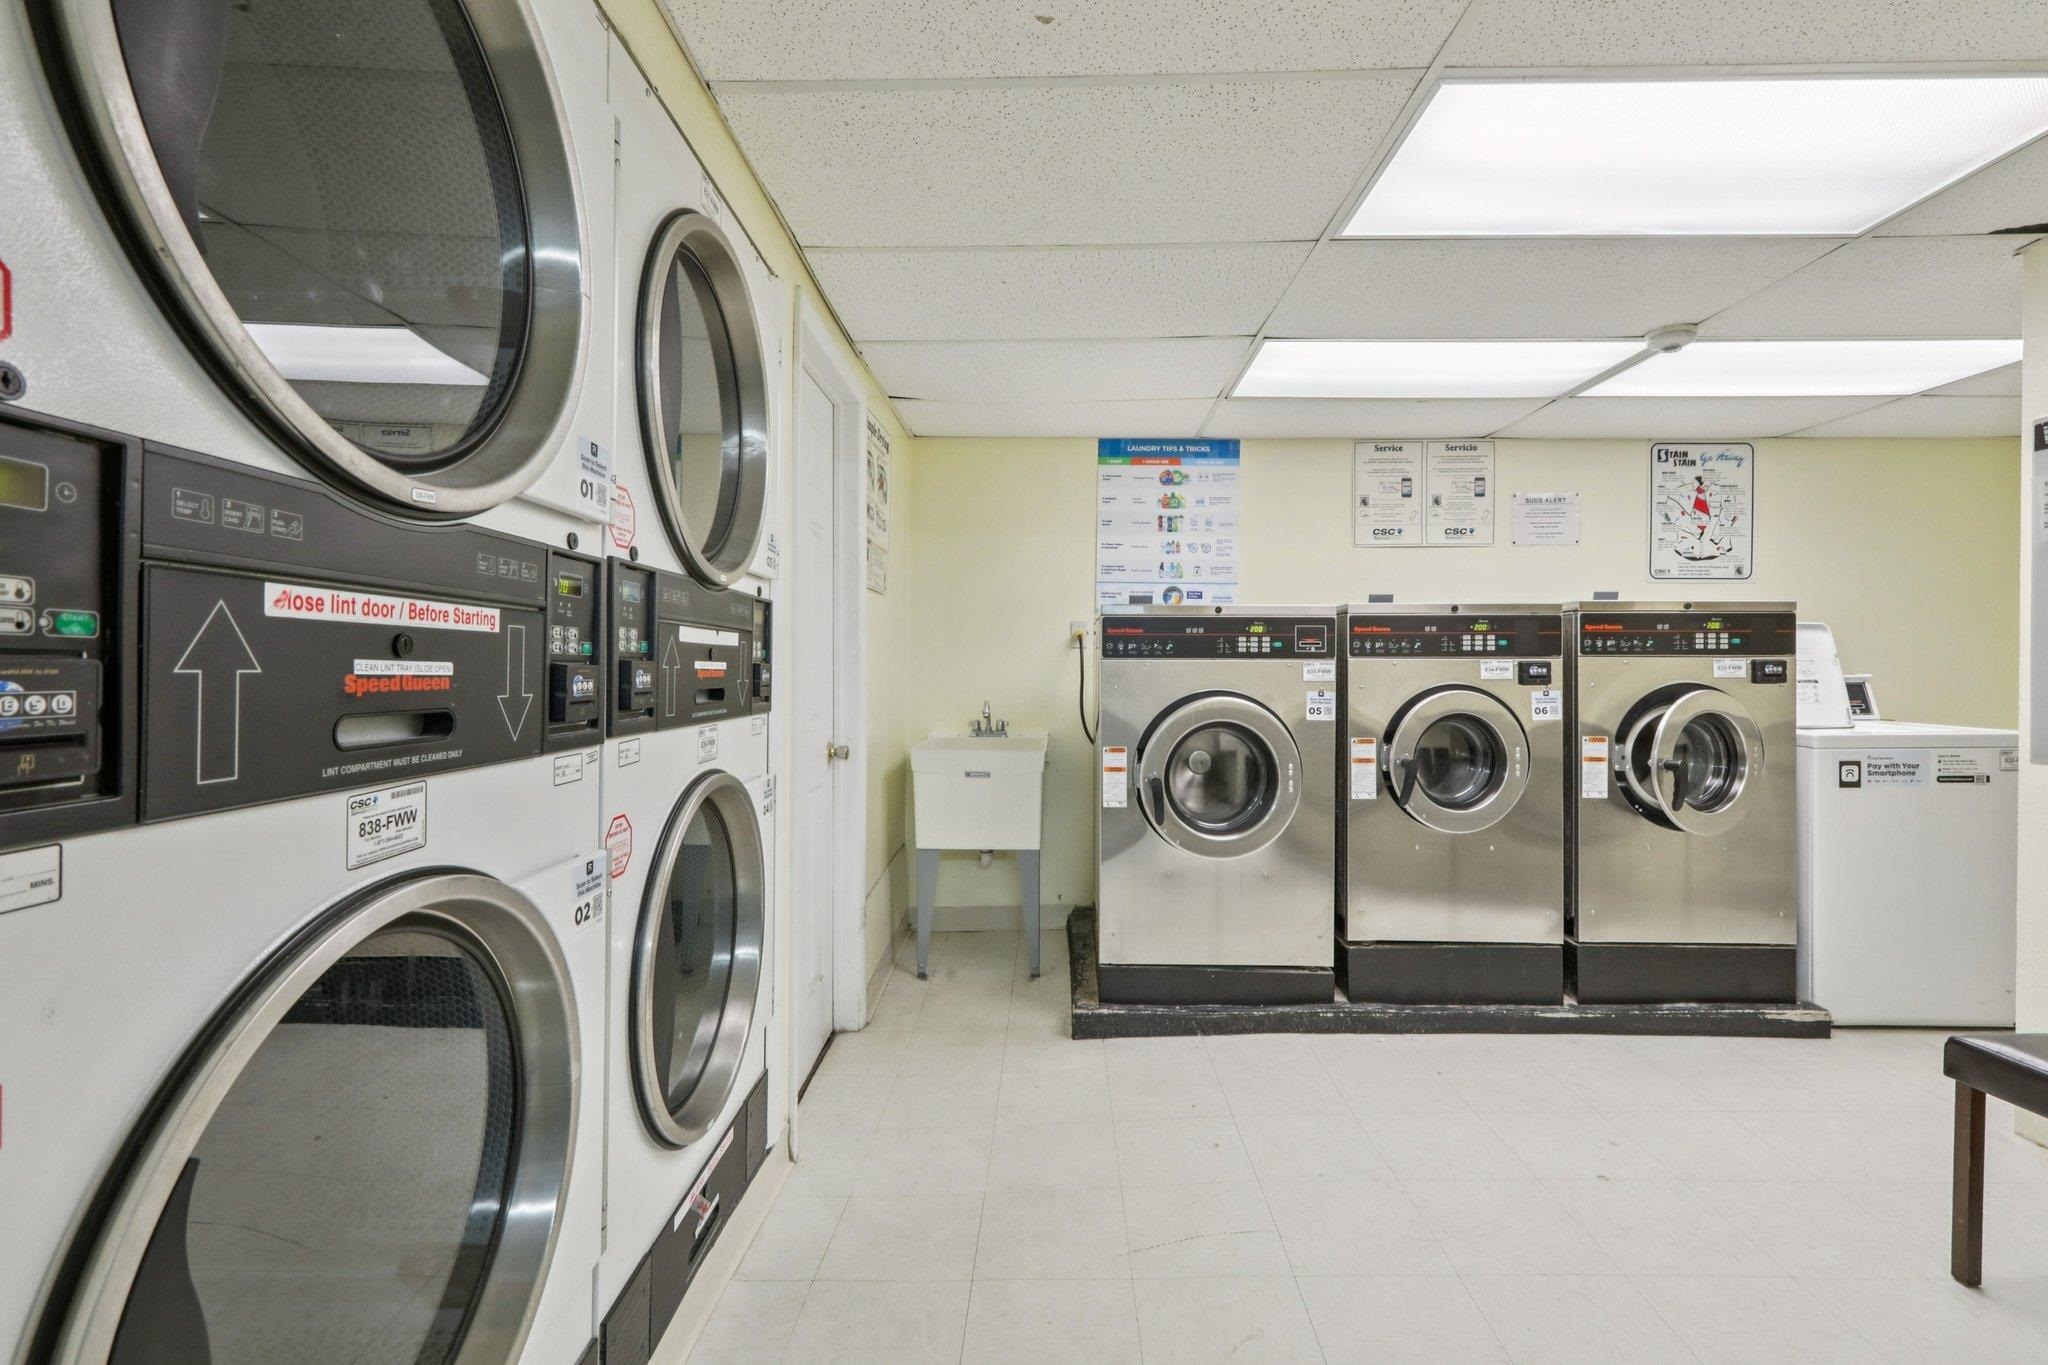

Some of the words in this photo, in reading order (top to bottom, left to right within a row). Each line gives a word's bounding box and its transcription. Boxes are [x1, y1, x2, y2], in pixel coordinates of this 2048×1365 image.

[1374, 443, 1404, 452] Service
[1445, 443, 1478, 452] Servicio
[1673, 459, 1697, 468] STAIN
[1700, 451, 1714, 467] Go
[581, 478, 594, 501] 01
[1372, 528, 1396, 536] CSC
[1444, 527, 1468, 536] CSC
[331, 593, 357, 616] lint
[361, 598, 396, 619] door
[399, 601, 405, 620] /
[408, 602, 450, 623] Before
[453, 606, 497, 631] Starting
[1250, 625, 1264, 633] 200
[355, 662, 379, 672] CLEAN
[380, 663, 394, 672] LINT
[397, 664, 413, 672] TRAY
[345, 673, 400, 697] Speed
[401, 673, 450, 692] Queen
[1308, 706, 1322, 715] 05
[1534, 706, 1548, 715] 06
[322, 766, 339, 778] LINT
[340, 760, 392, 775] COMPARTMENT
[393, 756, 411, 767] MUST
[411, 755, 420, 765] BE
[420, 751, 448, 763] CLEANED
[447, 749, 463, 759] DAILY
[1867, 762, 1882, 770] Pay
[1901, 762, 1920, 770] Your
[1867, 769, 1916, 777] Smartphone
[350, 797, 372, 810] CSC
[358, 808, 418, 838] 838-FWW
[574, 902, 591, 926] 02
